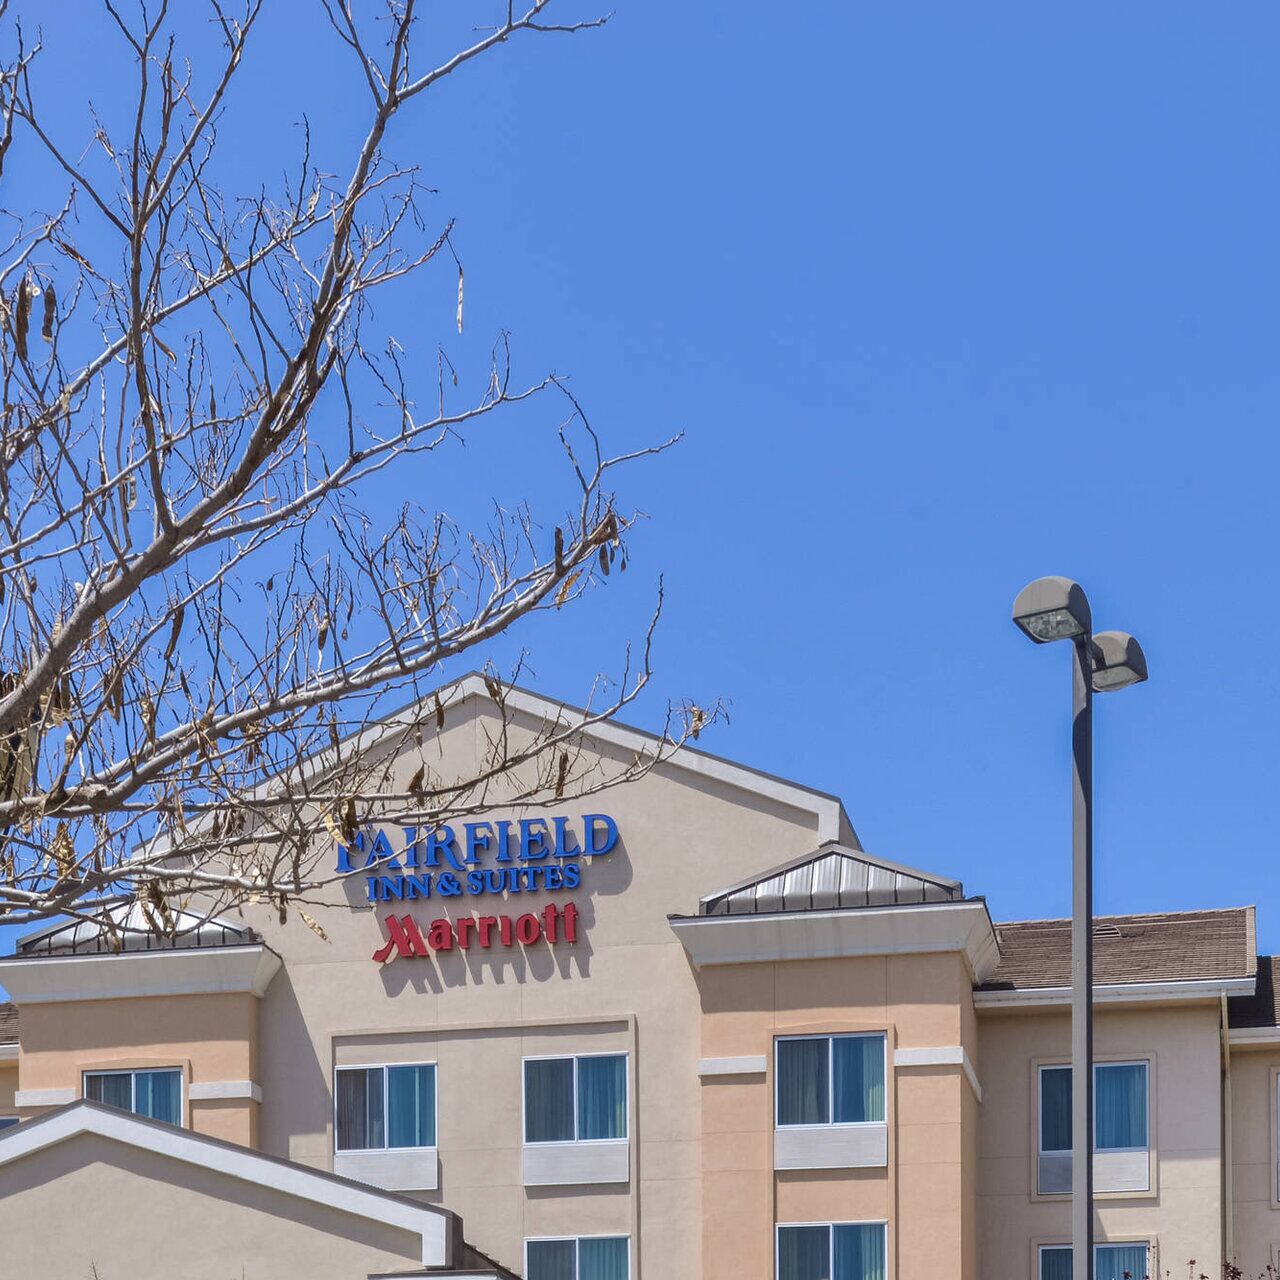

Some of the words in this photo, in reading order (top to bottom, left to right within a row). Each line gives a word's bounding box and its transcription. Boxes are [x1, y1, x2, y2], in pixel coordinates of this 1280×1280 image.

[366, 873, 432, 902] INN
[437, 871, 463, 896] &
[467, 863, 581, 895] SUITES
[372, 902, 579, 963] Marriott
